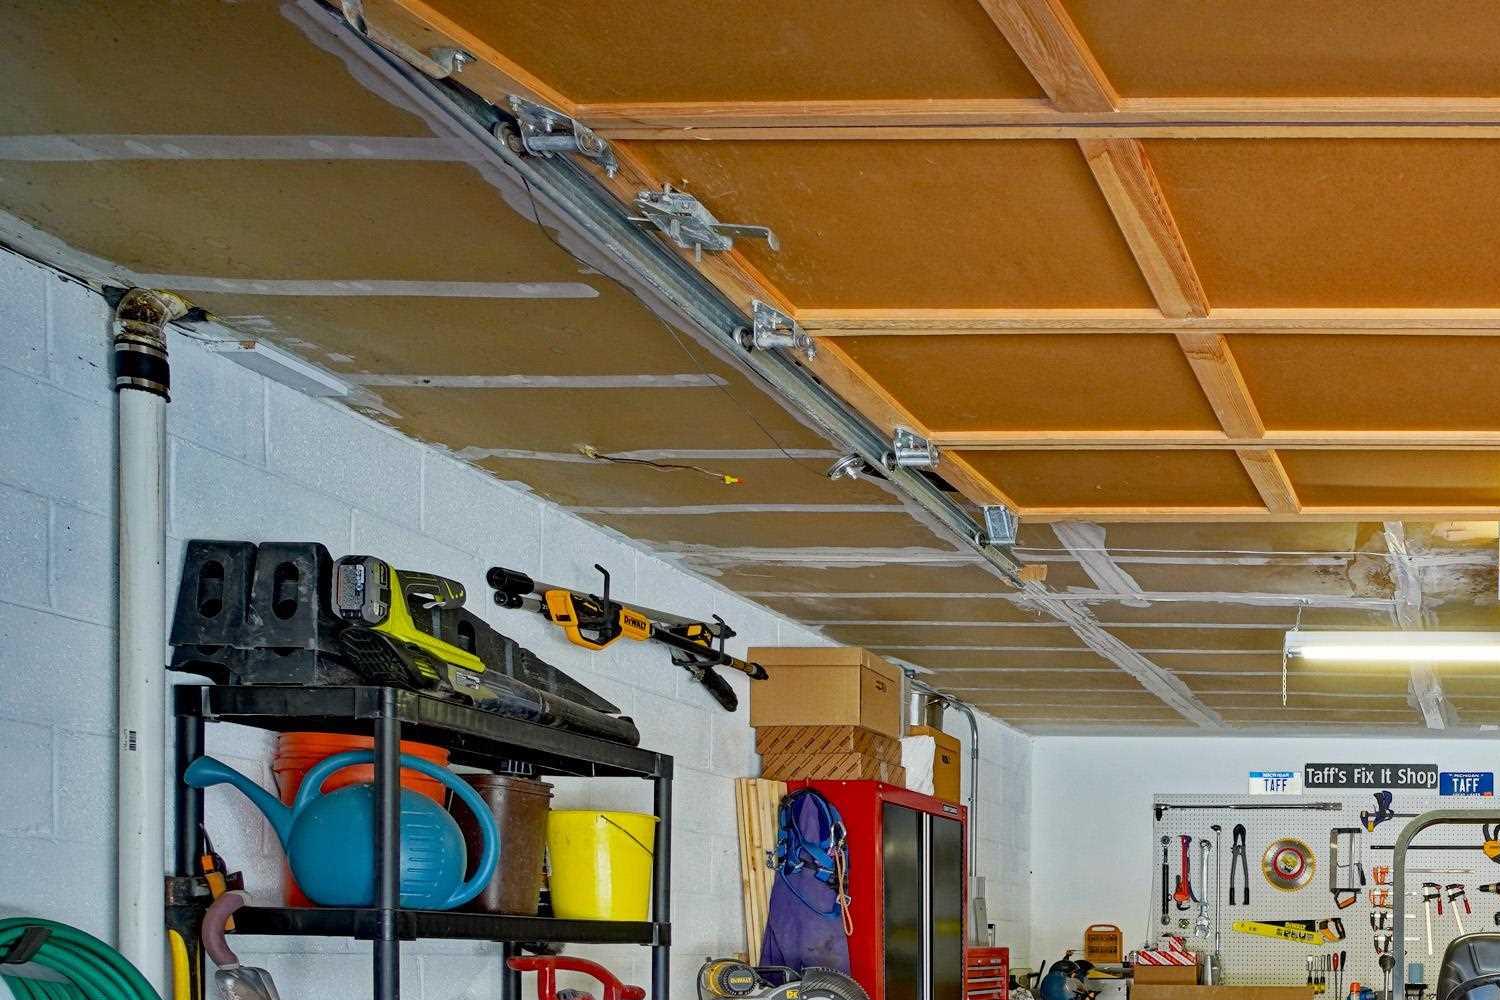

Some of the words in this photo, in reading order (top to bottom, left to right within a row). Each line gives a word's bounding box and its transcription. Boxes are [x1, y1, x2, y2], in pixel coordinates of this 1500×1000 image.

[1306, 768, 1347, 784] Taff's
[1354, 768, 1374, 784] Fix
[1381, 768, 1392, 784] It
[1398, 767, 1437, 787] Shop
[1264, 778, 1287, 792] TAFF
[1452, 778, 1480, 792] TAFF
